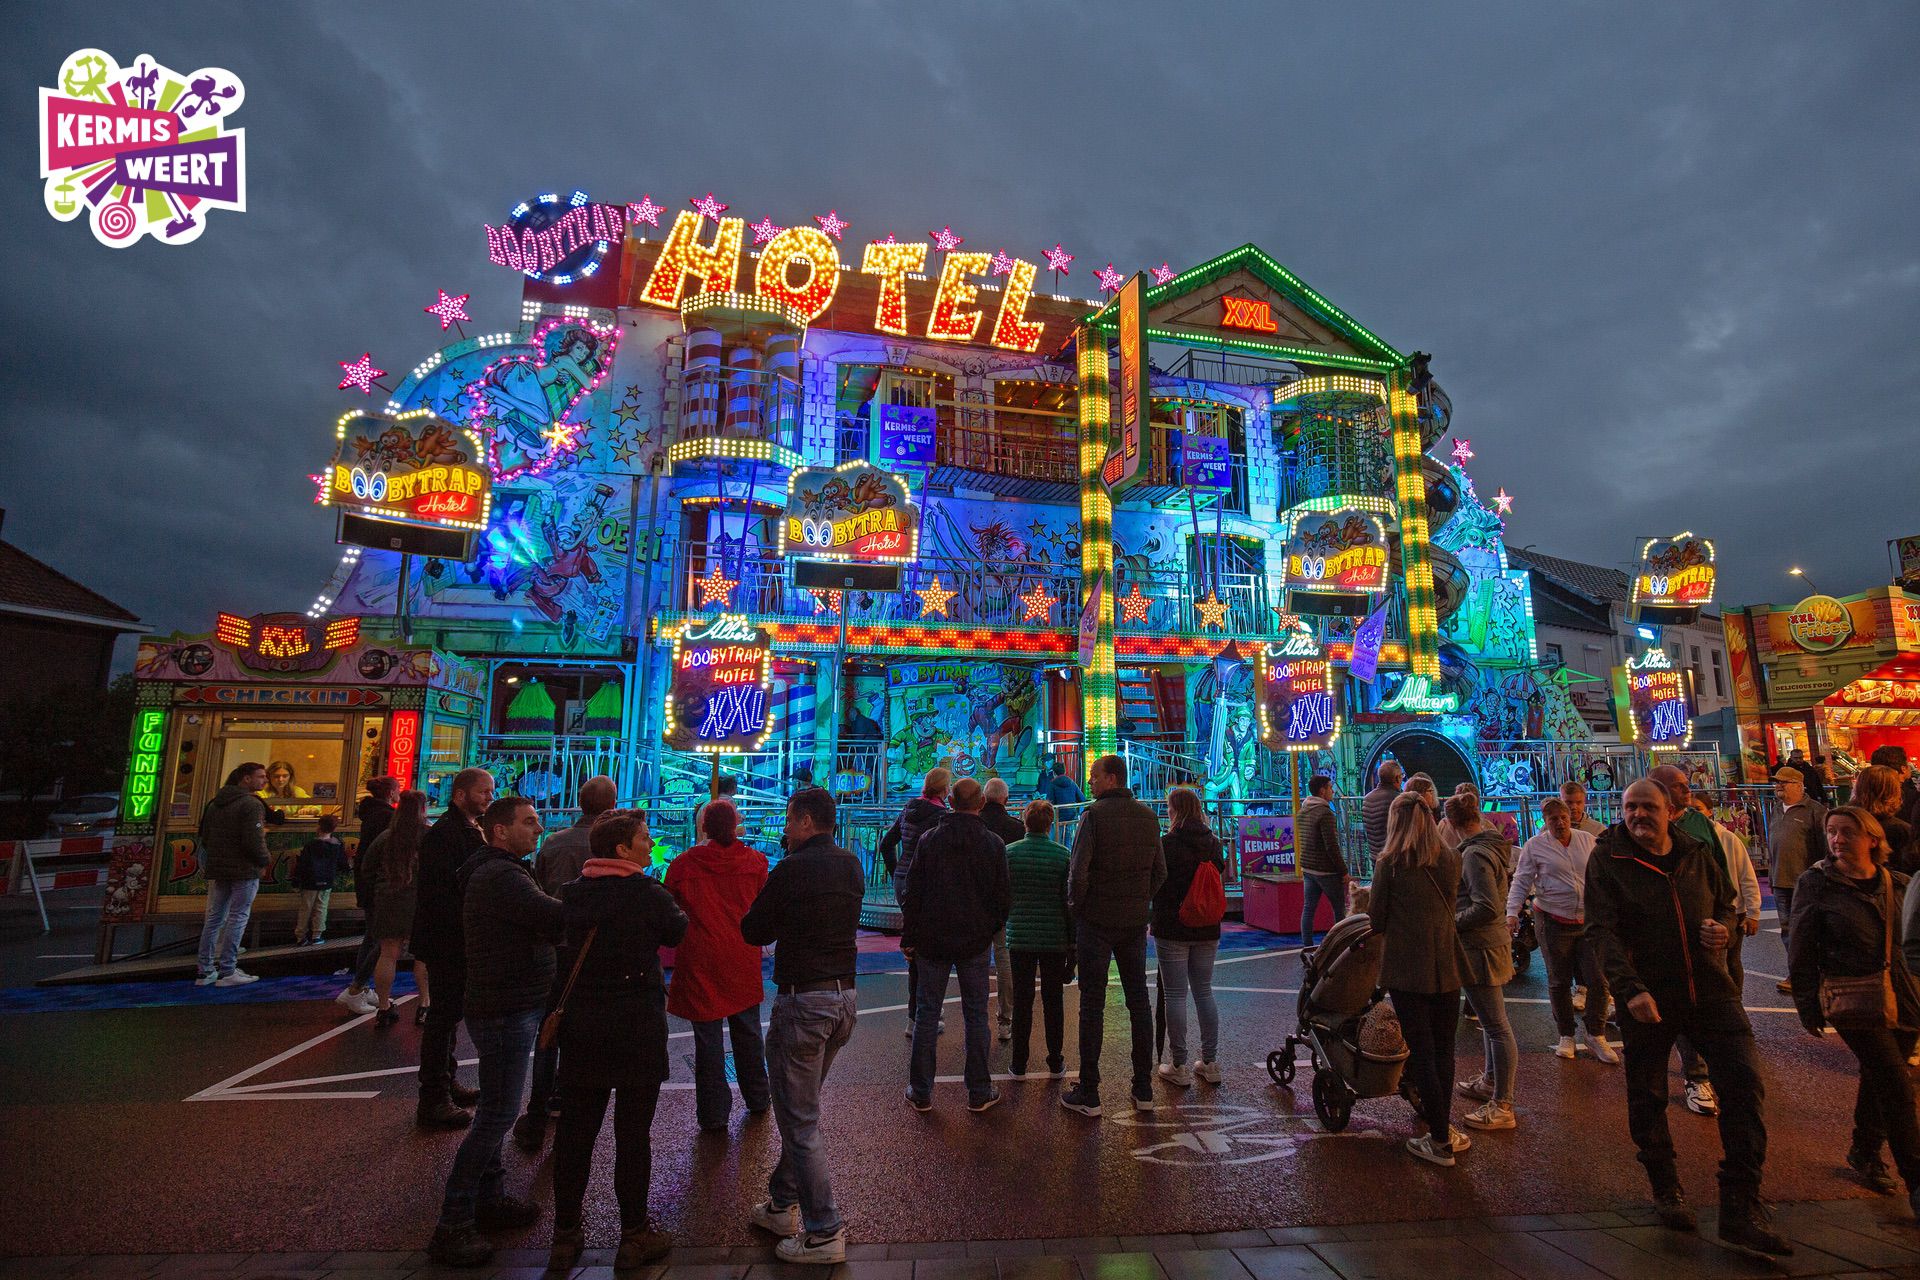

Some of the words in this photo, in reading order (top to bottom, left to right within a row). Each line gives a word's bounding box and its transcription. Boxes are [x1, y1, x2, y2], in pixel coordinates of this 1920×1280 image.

[485, 203, 624, 273] BOOBYTRAP
[640, 209, 1045, 352] HOTEL
[1219, 296, 1279, 333] XXL
[884, 421, 917, 433] KERMIS
[903, 433, 931, 446] WEERT
[1186, 450, 1214, 462] KERMIS
[1202, 461, 1226, 473] WEERT
[335, 465, 483, 502] BOOBYTRAP
[417, 496, 467, 513] Hotel
[788, 509, 912, 547] BOOBYTRAP
[861, 533, 900, 553] Hotel
[1290, 546, 1385, 580] BOOBYTRAP
[1344, 567, 1376, 583] Hotel
[1641, 566, 1715, 596] BOOBYTRAP
[1682, 583, 1708, 598] Hotel
[1788, 612, 1815, 625] XXL
[1797, 621, 1852, 638] Frites
[259, 625, 311, 657] XXL
[682, 647, 762, 670] BOOBYTRAP
[714, 668, 755, 683] HOTEL
[1267, 661, 1325, 682] BOOBYTRAP
[1632, 672, 1676, 690] BOOBYTRAP
[1292, 678, 1323, 692] HOTEL
[1378, 676, 1456, 712] Albers
[1653, 687, 1676, 700] HOTEL
[1775, 682, 1812, 692] DELICIOUS
[1812, 681, 1834, 690] FOOD
[700, 684, 765, 738] XXL
[1289, 692, 1333, 739] XXL
[1652, 700, 1687, 741] XXL
[131, 712, 163, 817] FUNNY
[393, 718, 415, 791] HOTE
[1244, 840, 1280, 853] KERMIS
[1266, 852, 1295, 865] WEERT
